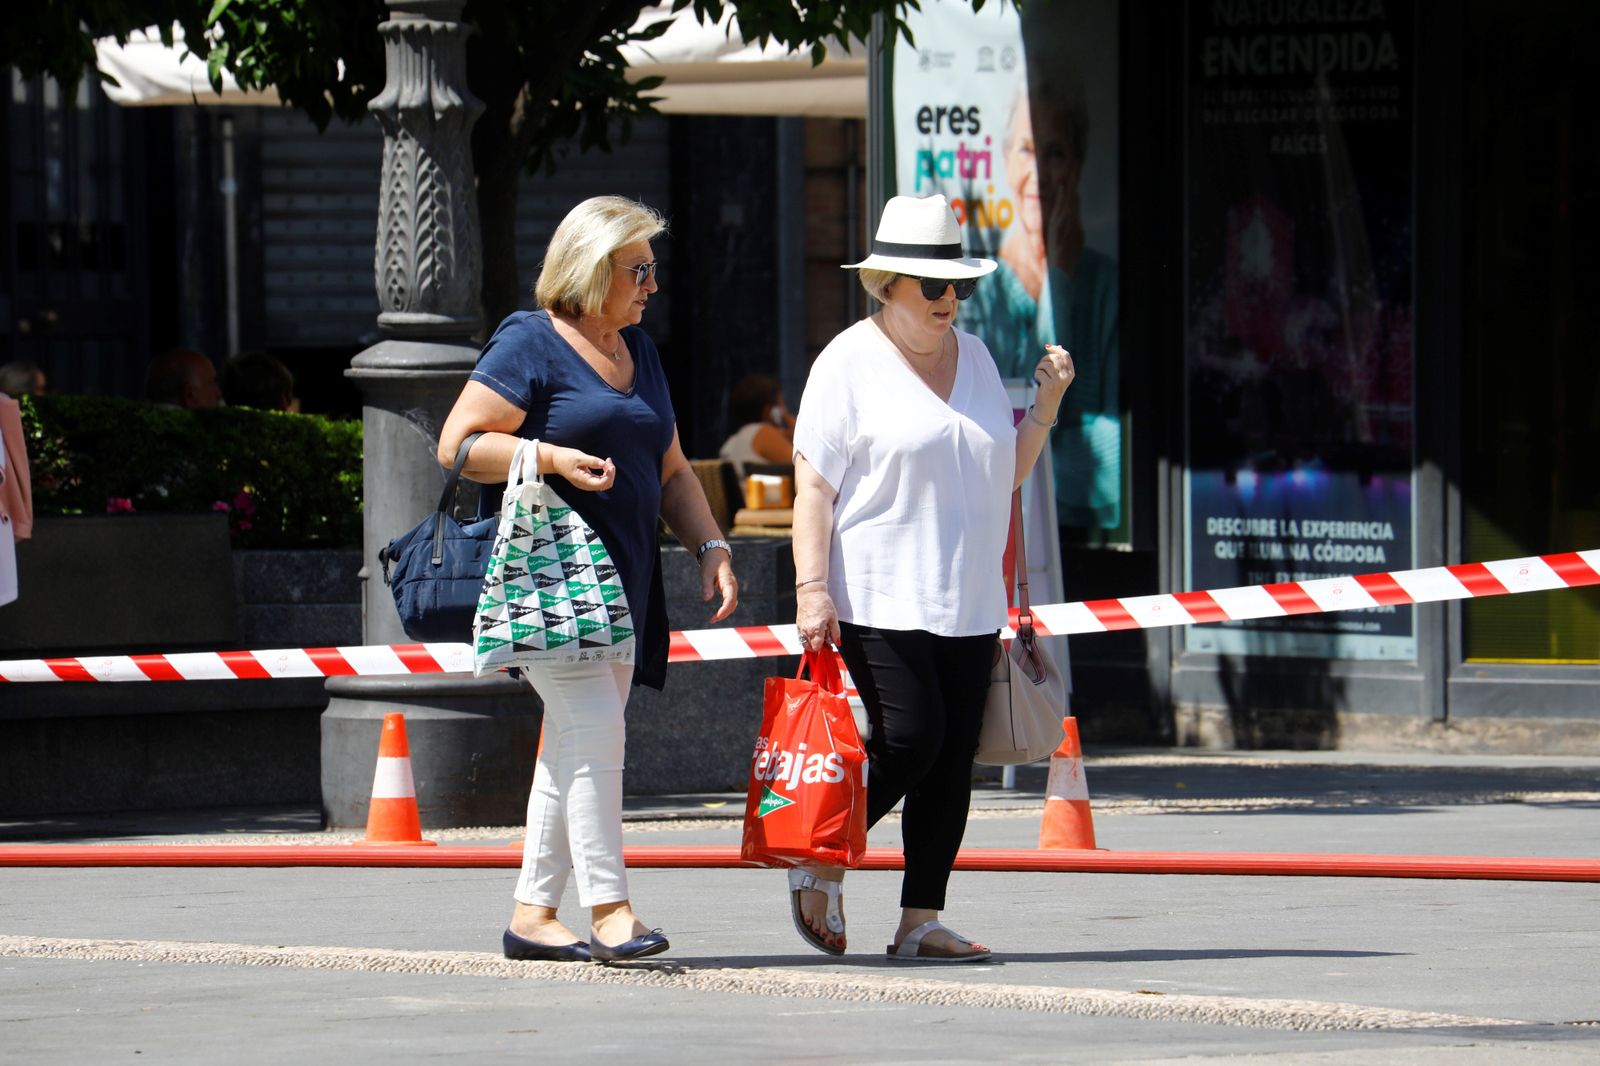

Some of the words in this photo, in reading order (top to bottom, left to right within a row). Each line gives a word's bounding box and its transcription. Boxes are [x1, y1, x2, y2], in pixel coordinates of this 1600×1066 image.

[1213, 0, 1386, 25] NATURALEZA
[1202, 32, 1399, 77] ENCENDIDA
[917, 105, 980, 135] eres
[915, 136, 992, 191] patri
[950, 185, 1013, 228] onio
[1207, 517, 1277, 536] DESCUBRE
[1280, 519, 1299, 538] LA
[1302, 521, 1394, 540] EXPERIENCIA
[1215, 542, 1244, 559] QUE
[1313, 540, 1386, 563] CÓRDOBA
[755, 736, 769, 750] as
